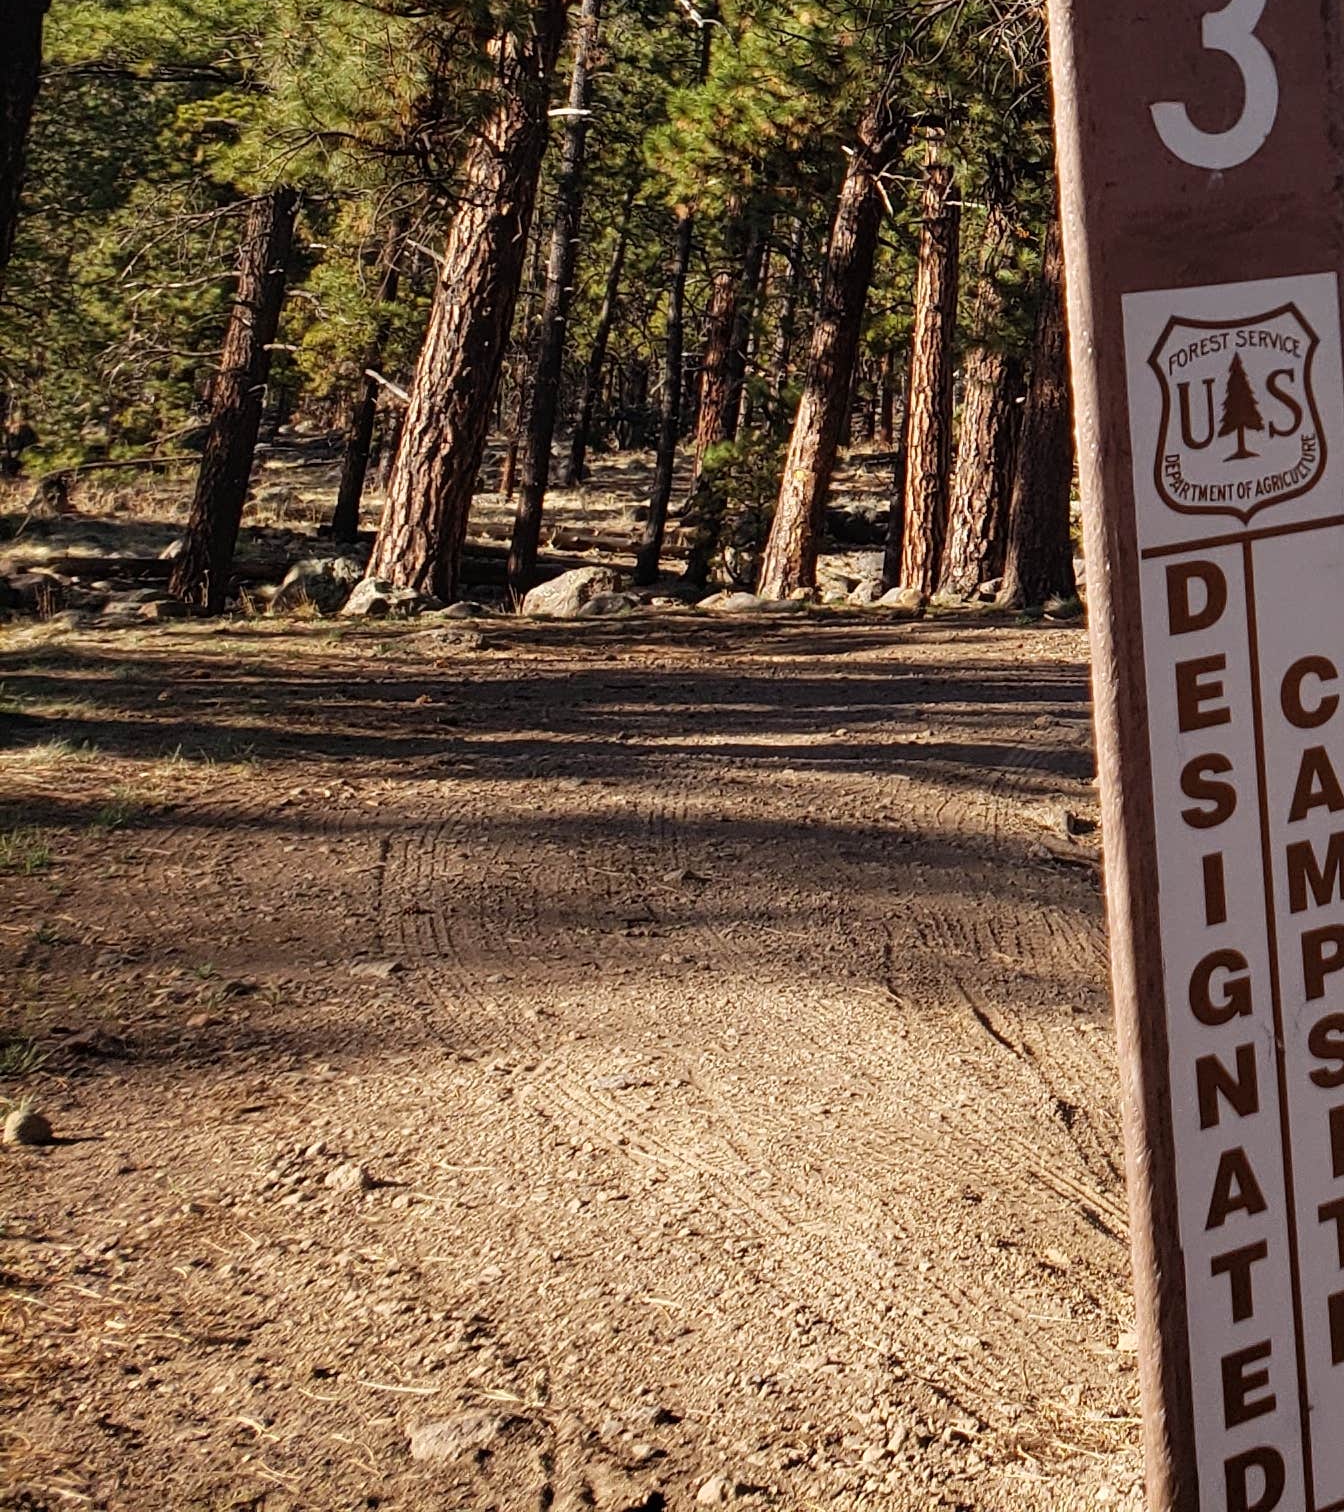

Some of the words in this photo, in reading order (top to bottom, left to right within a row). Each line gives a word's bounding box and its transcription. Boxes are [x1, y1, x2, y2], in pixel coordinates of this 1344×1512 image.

[1168, 332, 1231, 376] FOREST
[1236, 330, 1302, 358] SERVICE
[1164, 454, 1235, 502] DEPARTMENT
[1236, 482, 1255, 500] OF
[1255, 433, 1316, 498] AGRICULTURE
[1165, 560, 1286, 1512] DESIGNATED
